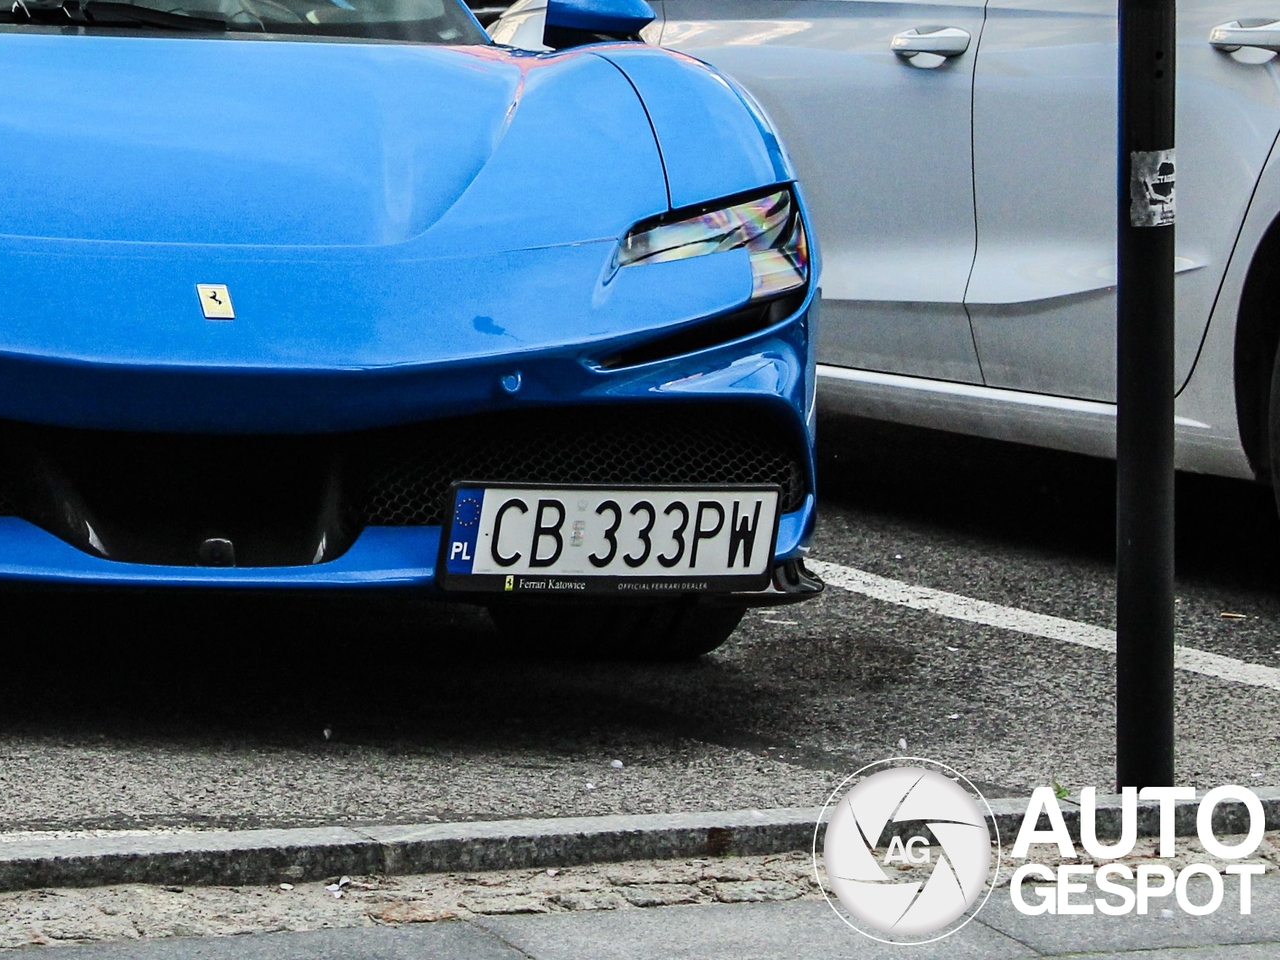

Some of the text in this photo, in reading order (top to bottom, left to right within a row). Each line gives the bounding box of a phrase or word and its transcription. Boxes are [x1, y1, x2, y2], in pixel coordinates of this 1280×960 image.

[491, 498, 762, 569] CB 333PW
[450, 542, 471, 560] PL
[519, 578, 586, 589] Ferrari Katowice
[618, 582, 708, 590] OFFICIAL FERRARI DEALER
